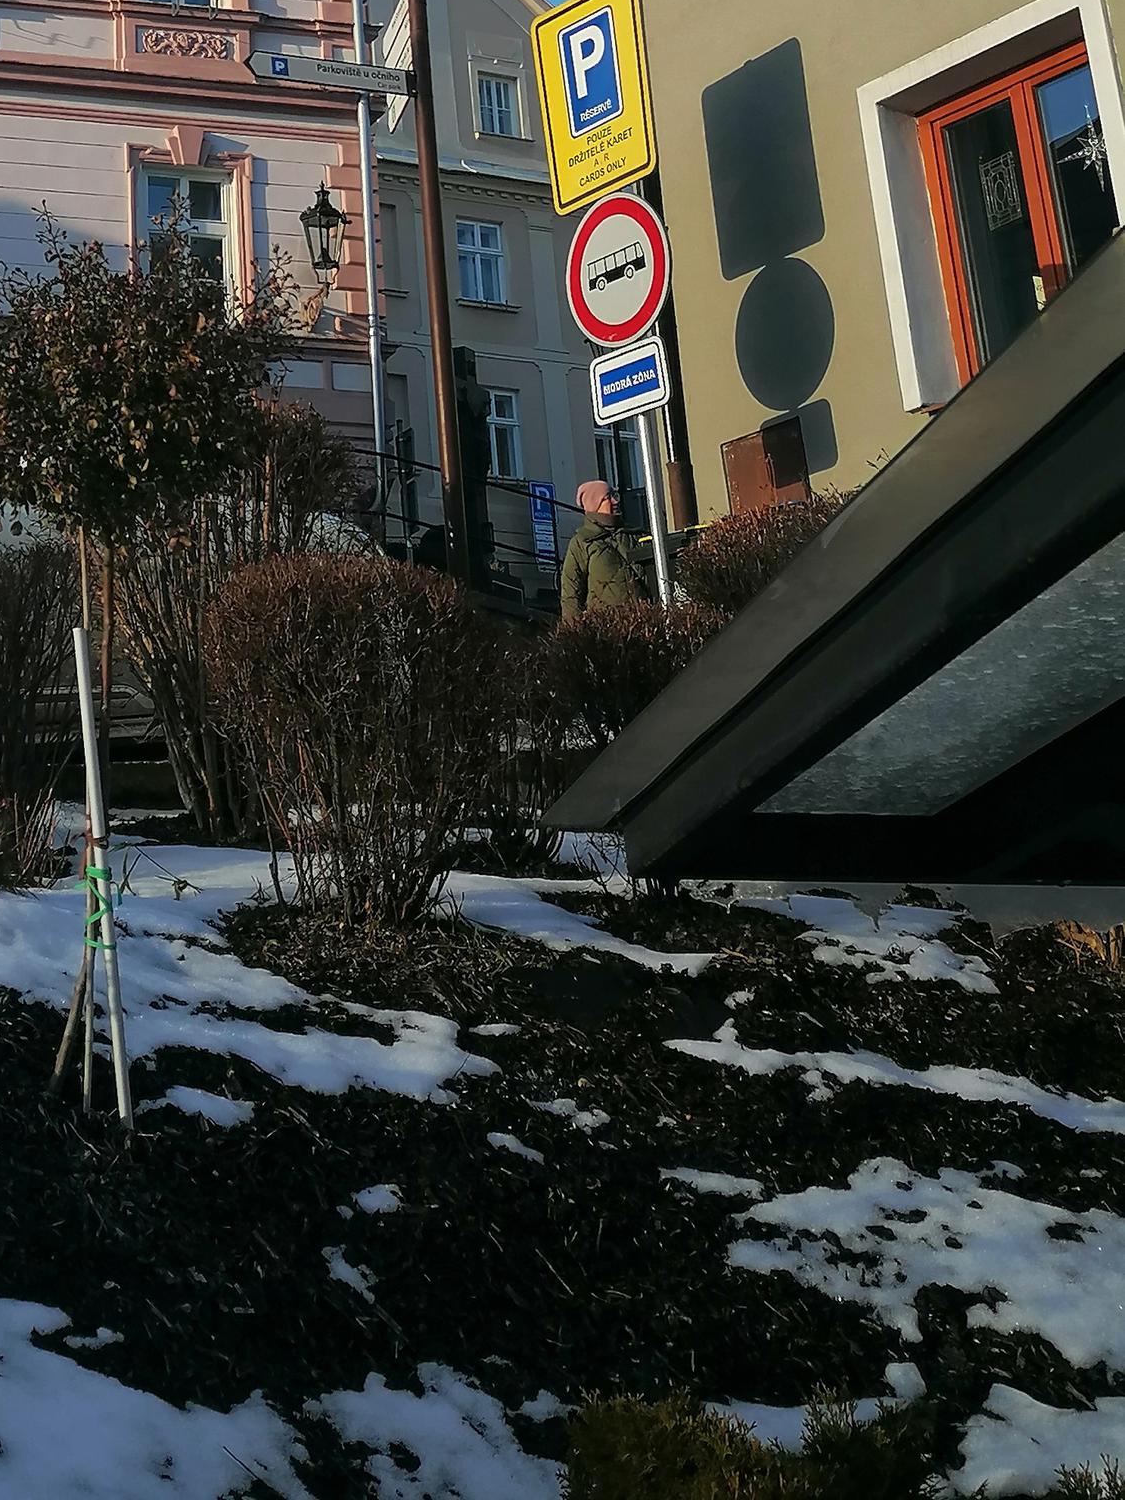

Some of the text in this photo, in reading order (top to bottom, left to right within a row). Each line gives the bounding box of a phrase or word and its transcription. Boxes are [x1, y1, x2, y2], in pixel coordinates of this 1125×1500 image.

[275, 62, 286, 73] P
[316, 63, 362, 77] Parkoviště
[371, 70, 400, 82] očního
[569, 24, 605, 100] P
[580, 98, 613, 122] RÉSERVÉ
[568, 127, 633, 168] DRŽITELÉ KARET
[586, 125, 613, 146] POUZE
[579, 156, 627, 187] CARDS ONLY
[603, 369, 656, 396] MODRÁ ZÓNA
